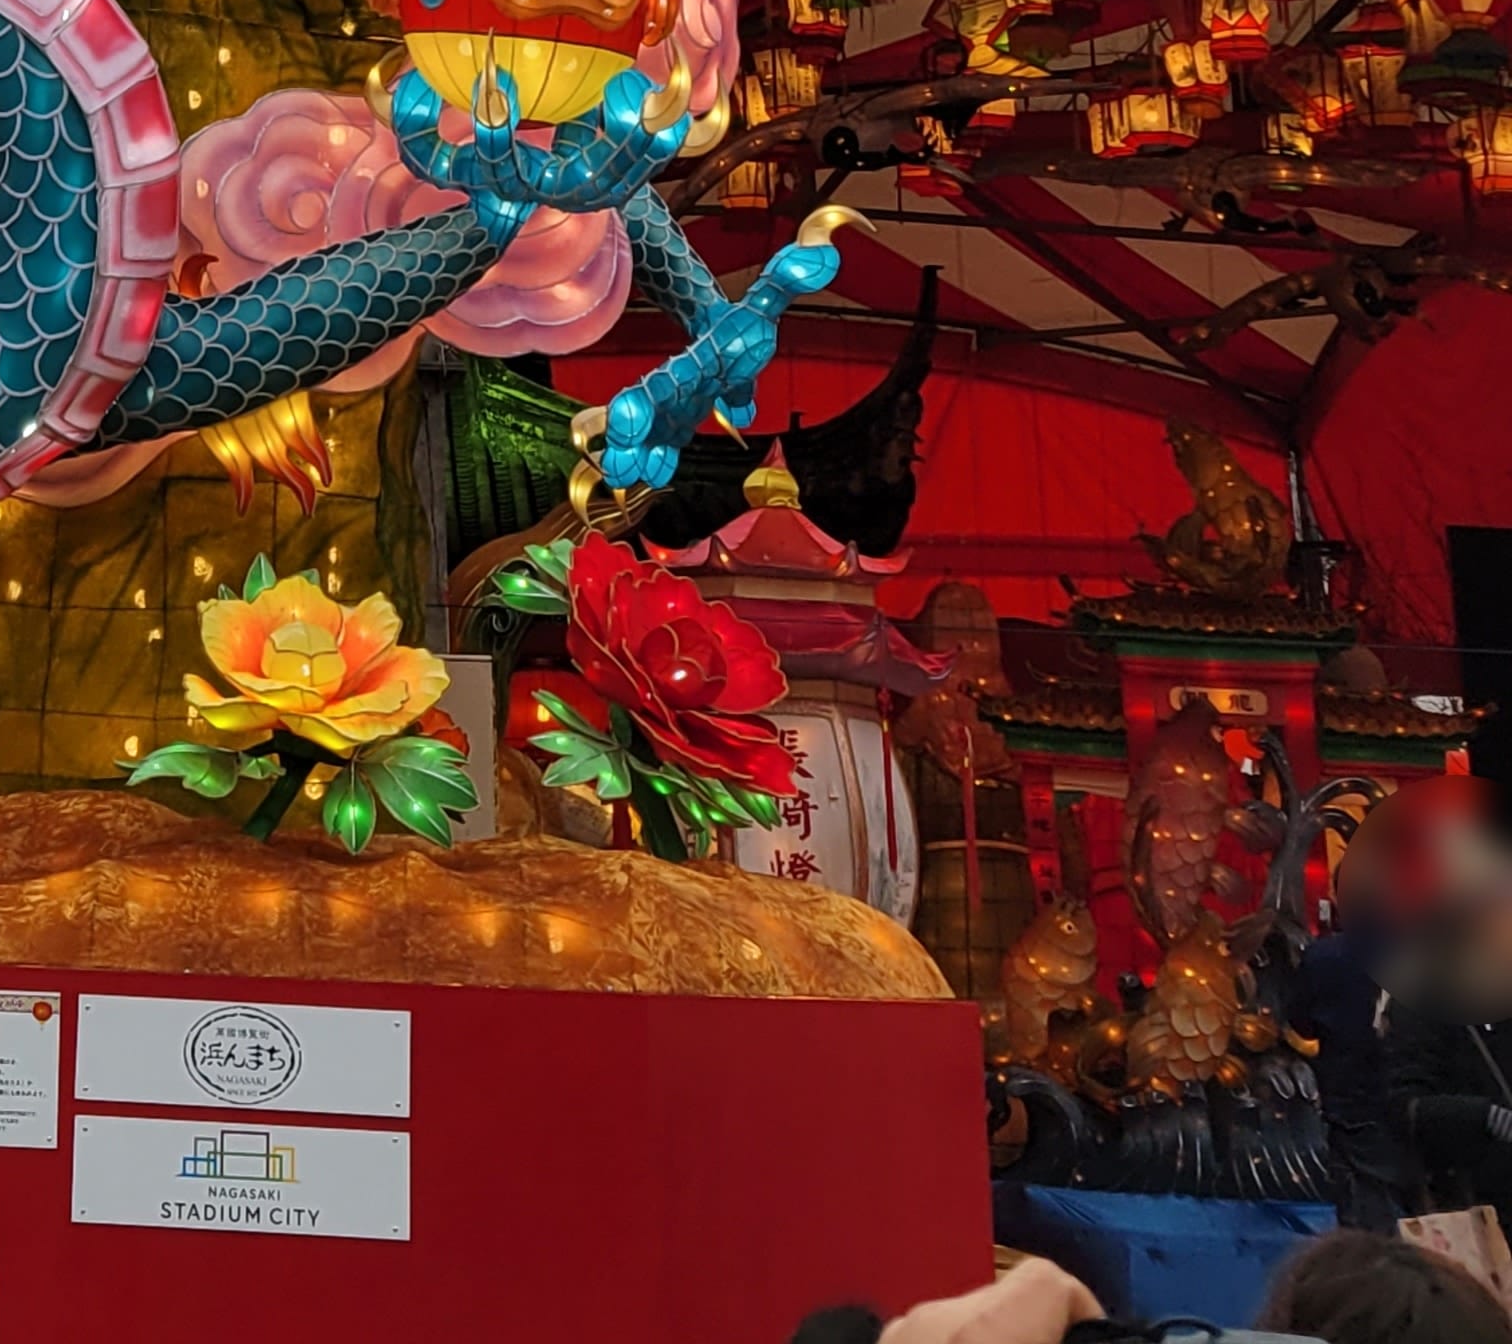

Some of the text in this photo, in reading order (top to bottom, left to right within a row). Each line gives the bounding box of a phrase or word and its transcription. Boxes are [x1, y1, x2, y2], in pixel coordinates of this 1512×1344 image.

[770, 728, 823, 882] 長崎燈
[200, 1041, 286, 1071] 浜んまち
[207, 1185, 281, 1201] NAGASAKI
[160, 1201, 321, 1228] STADIUM CITY
